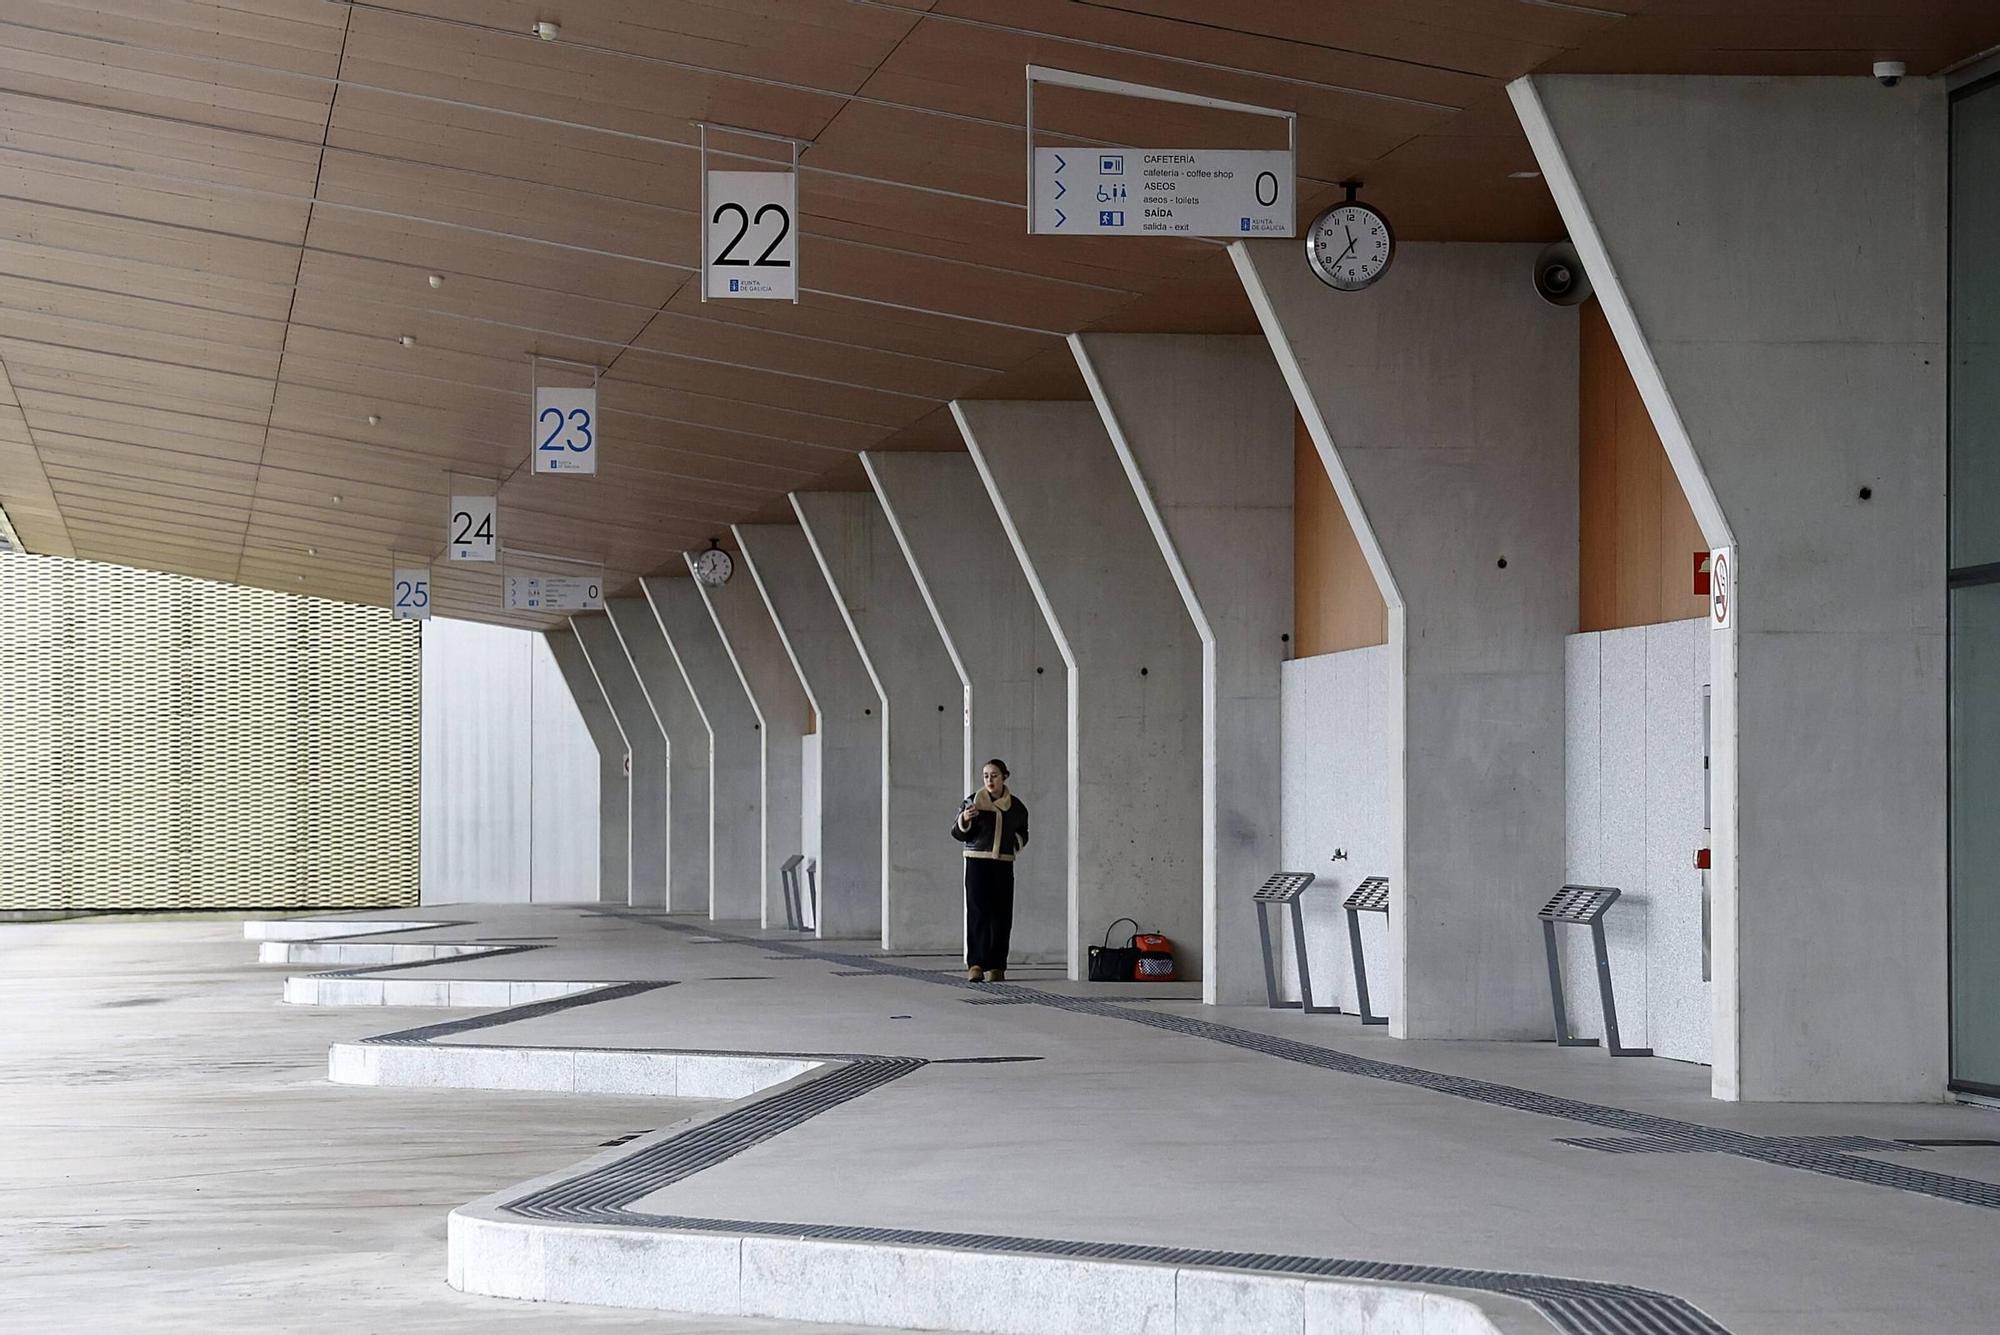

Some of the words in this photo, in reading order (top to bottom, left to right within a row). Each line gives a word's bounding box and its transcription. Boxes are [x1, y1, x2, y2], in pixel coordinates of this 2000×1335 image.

[1144, 154, 1195, 164] CAFETERÍA
[1187, 169, 1211, 178] coffee
[1214, 170, 1233, 179] shop
[1145, 182, 1176, 191] ASEOS
[1255, 171, 1278, 206] 0
[1144, 196, 1168, 204] aseos
[1175, 196, 1199, 205] toilets
[1144, 207, 1173, 217] SAÍDA
[1143, 222, 1167, 231] salida
[1175, 223, 1190, 231] exit
[712, 202, 791, 267] 22
[539, 407, 593, 452] 23
[453, 512, 494, 545] 24
[396, 581, 428, 607] 25
[588, 584, 598, 599] 0
